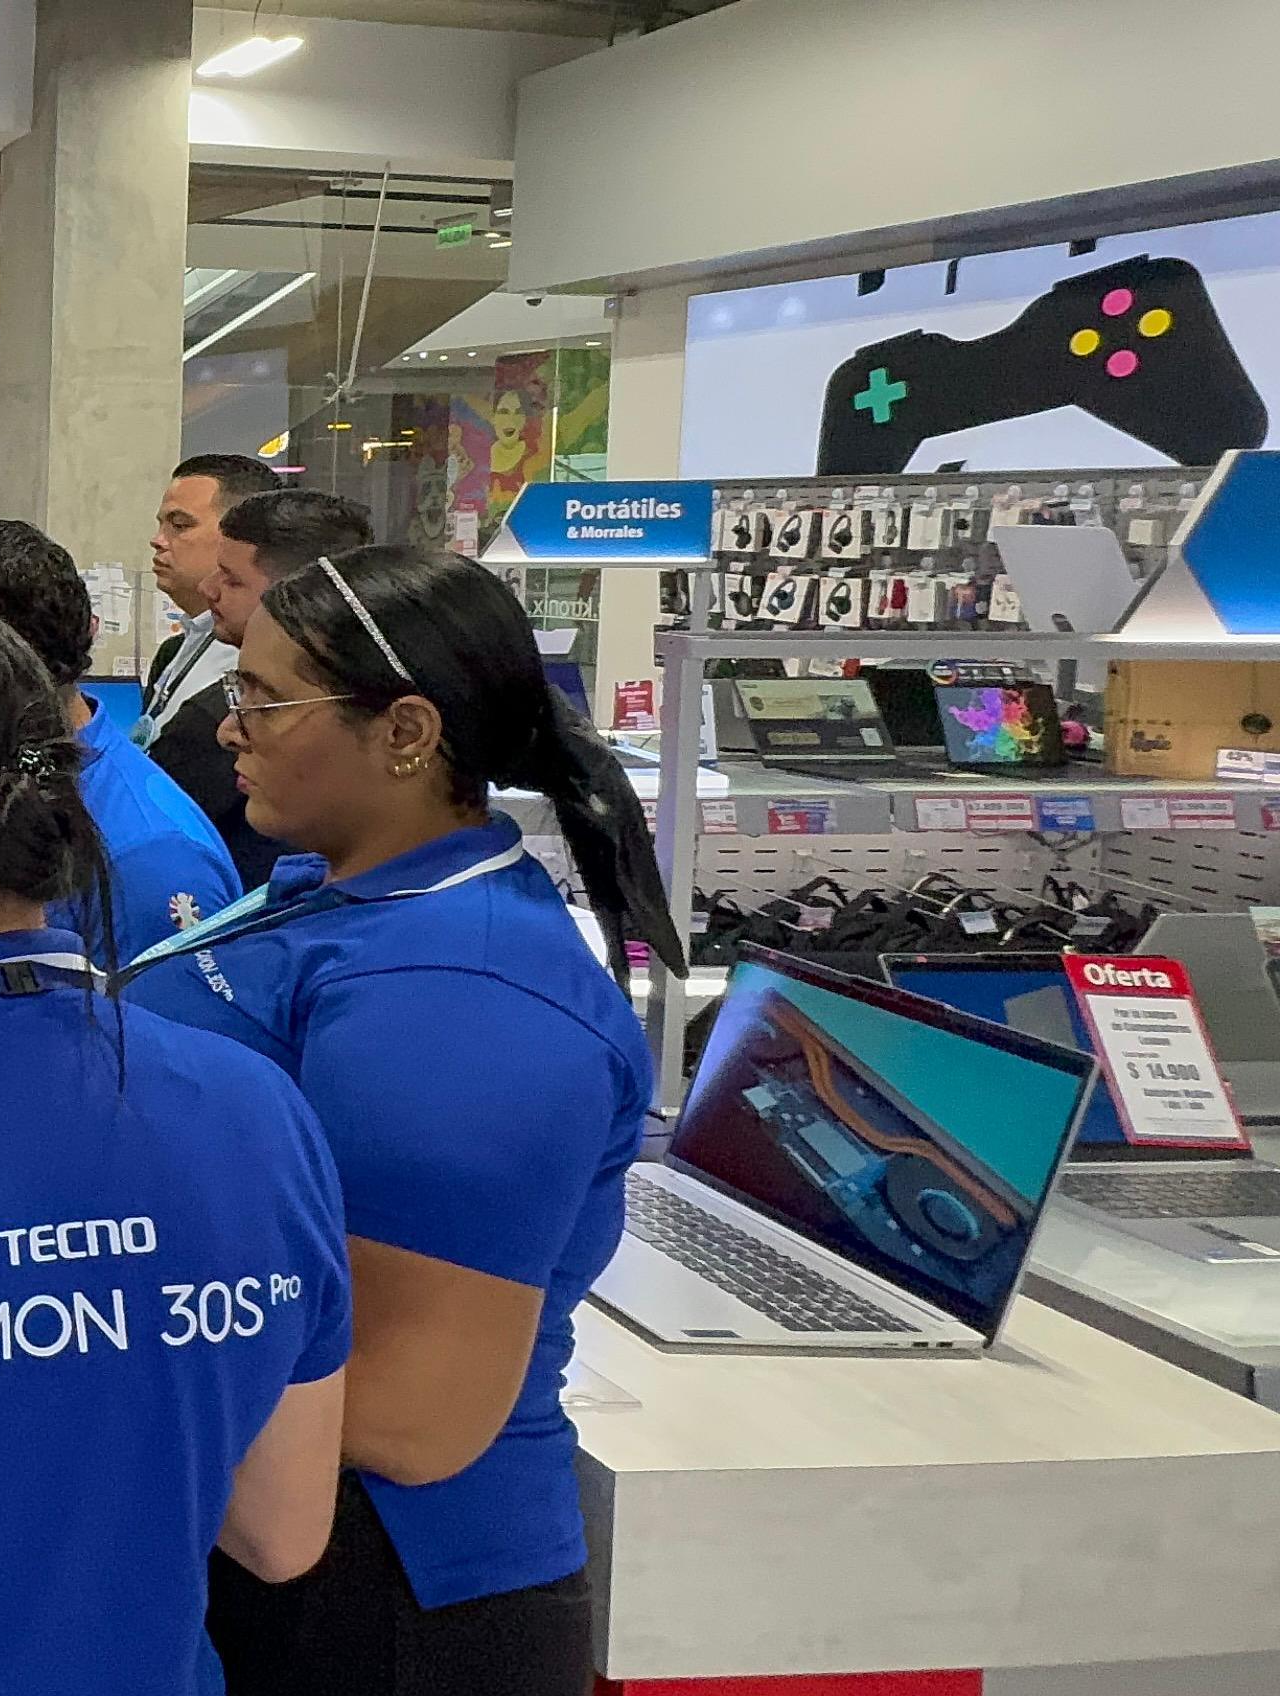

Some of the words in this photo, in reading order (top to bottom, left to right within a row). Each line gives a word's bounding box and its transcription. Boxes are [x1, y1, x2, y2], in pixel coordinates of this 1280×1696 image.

[565, 498, 681, 520] Portátiles
[566, 526, 579, 539] &
[581, 525, 644, 539] Morrales
[1083, 963, 1172, 989] Oferta
[160, 1276, 265, 1347] 30S
[269, 1273, 302, 1307] Pro
